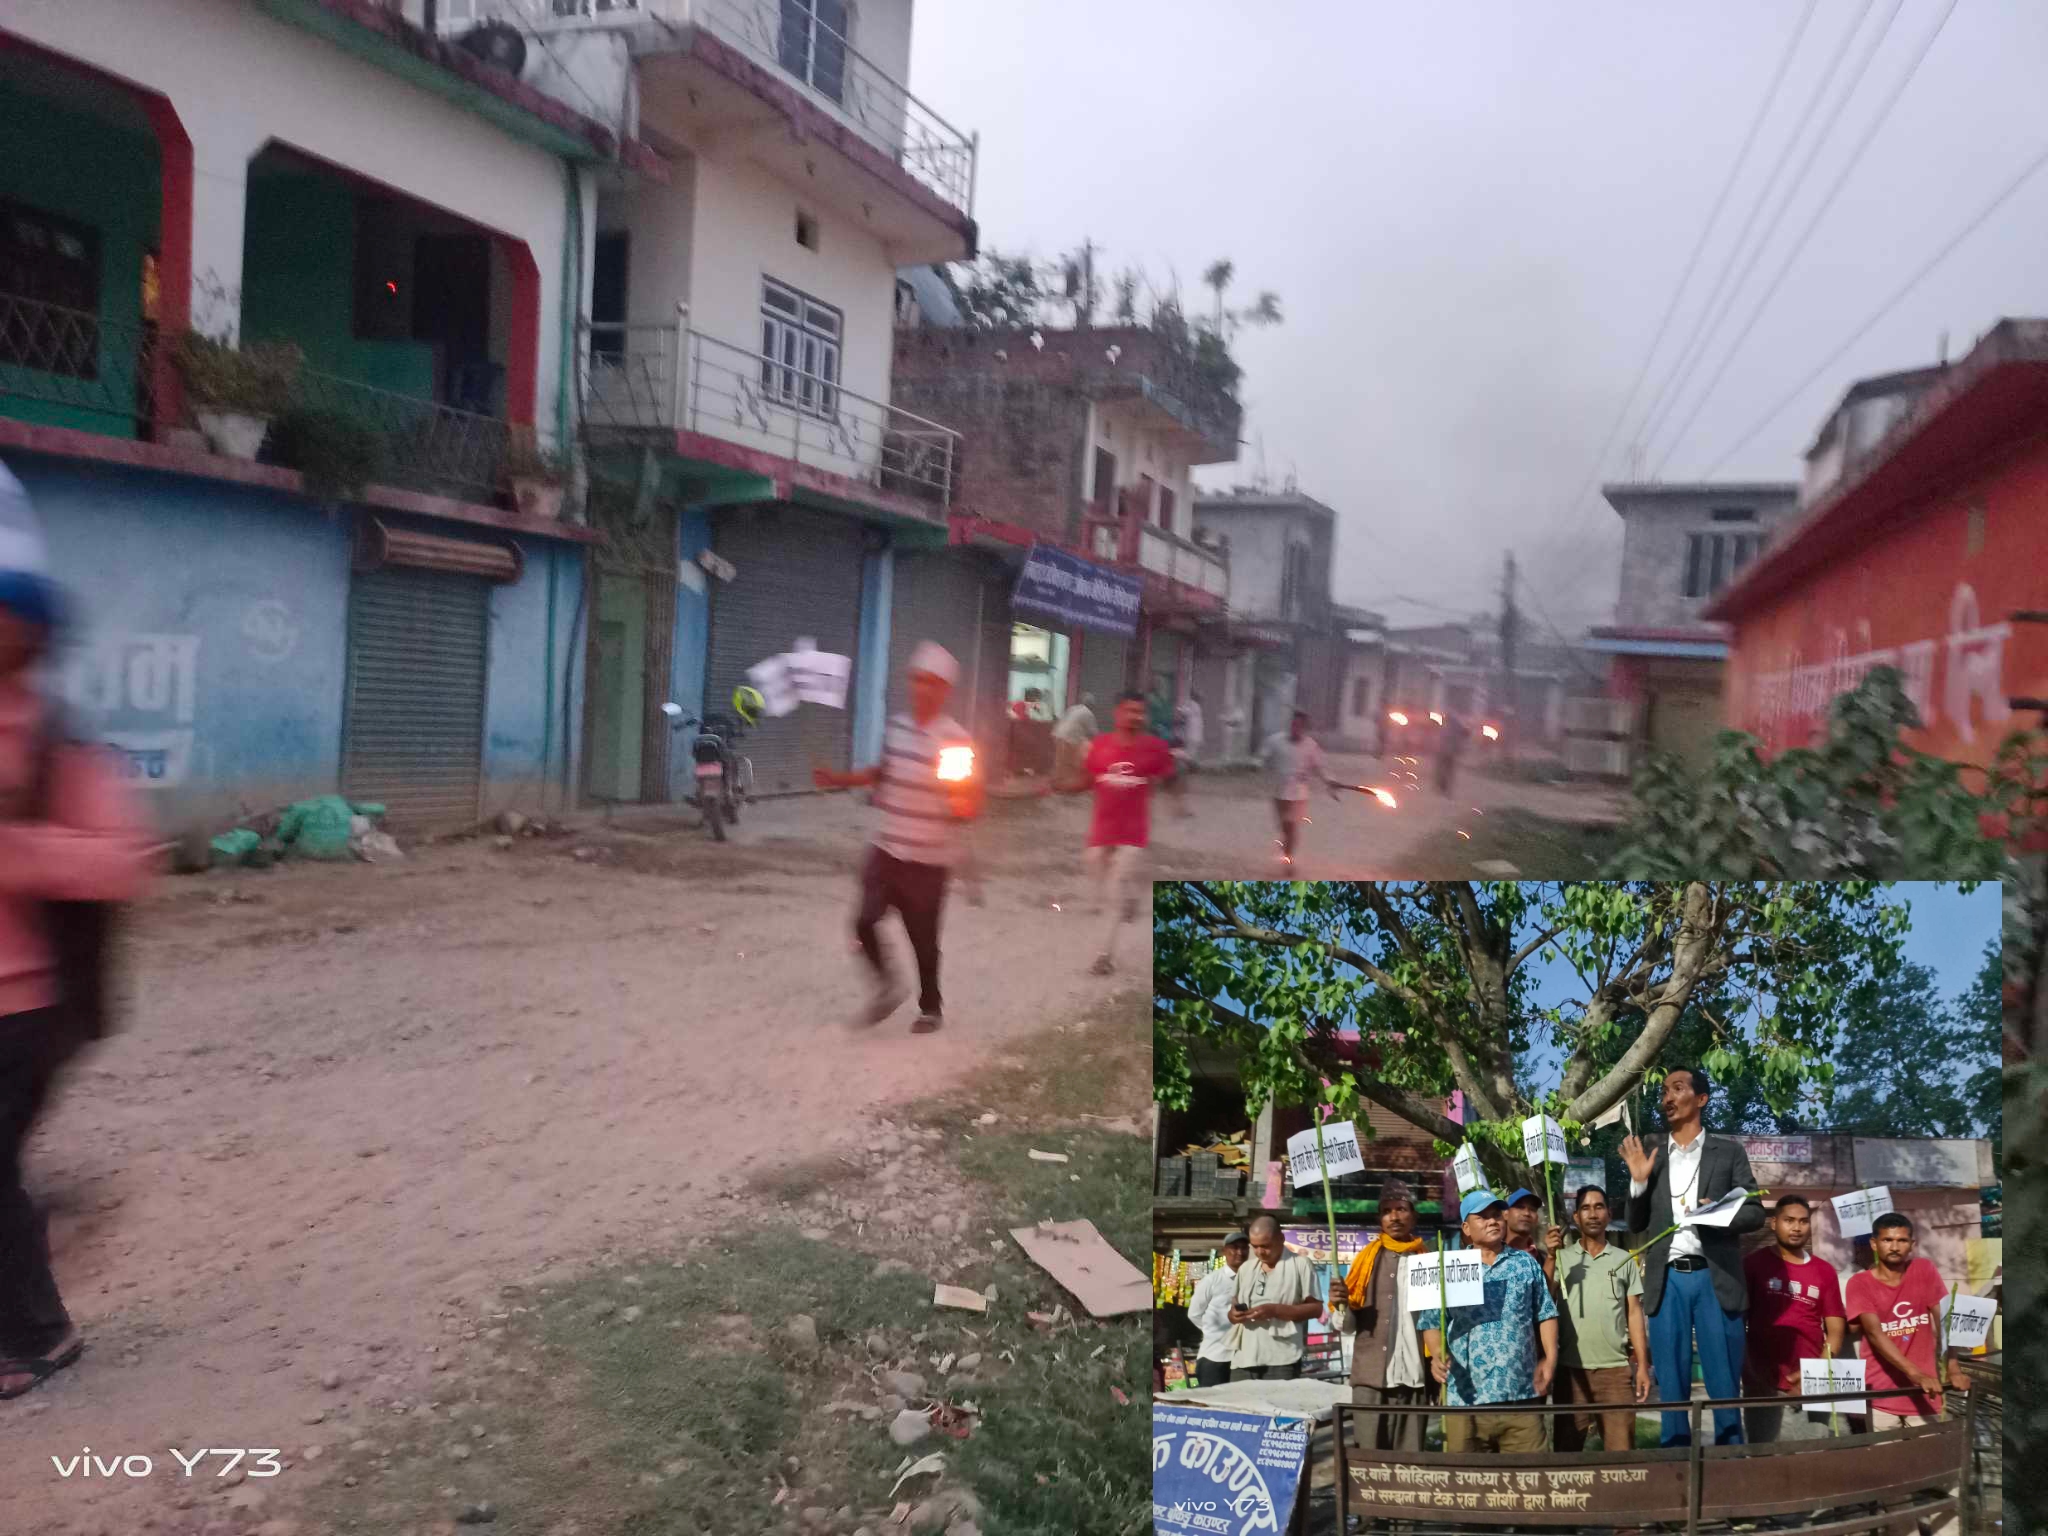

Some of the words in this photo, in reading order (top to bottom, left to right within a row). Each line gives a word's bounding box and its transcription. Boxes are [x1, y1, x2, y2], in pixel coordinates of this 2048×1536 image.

[1502, 1472, 1511, 1489] र
[1545, 1470, 1596, 1488] पुष्पराज
[1360, 1485, 1377, 1501] को
[1484, 1488, 1520, 1511] जोशी
